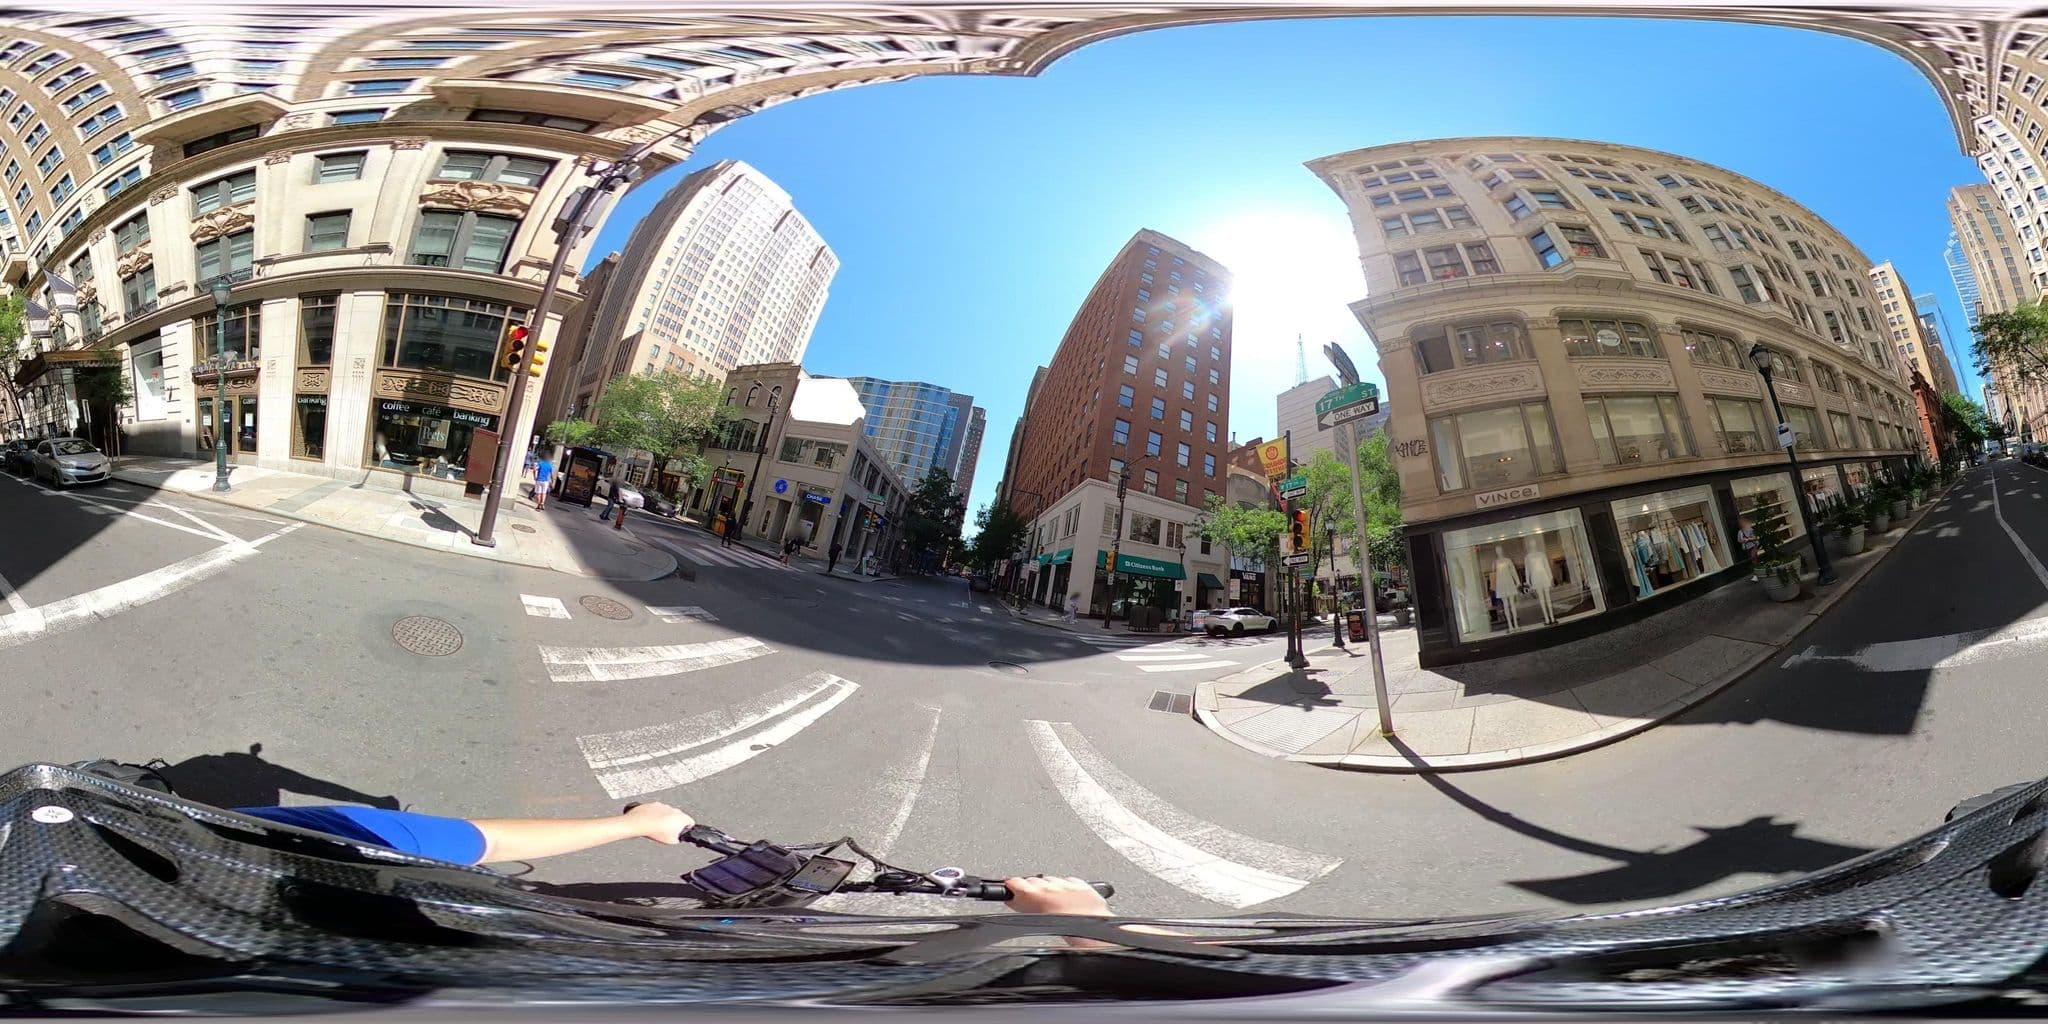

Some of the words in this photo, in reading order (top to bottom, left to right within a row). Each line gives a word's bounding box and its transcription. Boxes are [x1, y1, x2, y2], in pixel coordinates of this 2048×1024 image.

[1360, 388, 1376, 398] ST
[382, 401, 410, 412] coffee
[422, 406, 441, 416] café
[453, 409, 491, 427] banking
[1334, 409, 1351, 421] ONE
[1353, 402, 1372, 414] WAY
[806, 493, 822, 501] CHASE
[1130, 561, 1152, 570] Citizens
[1242, 572, 1257, 581] VANS
